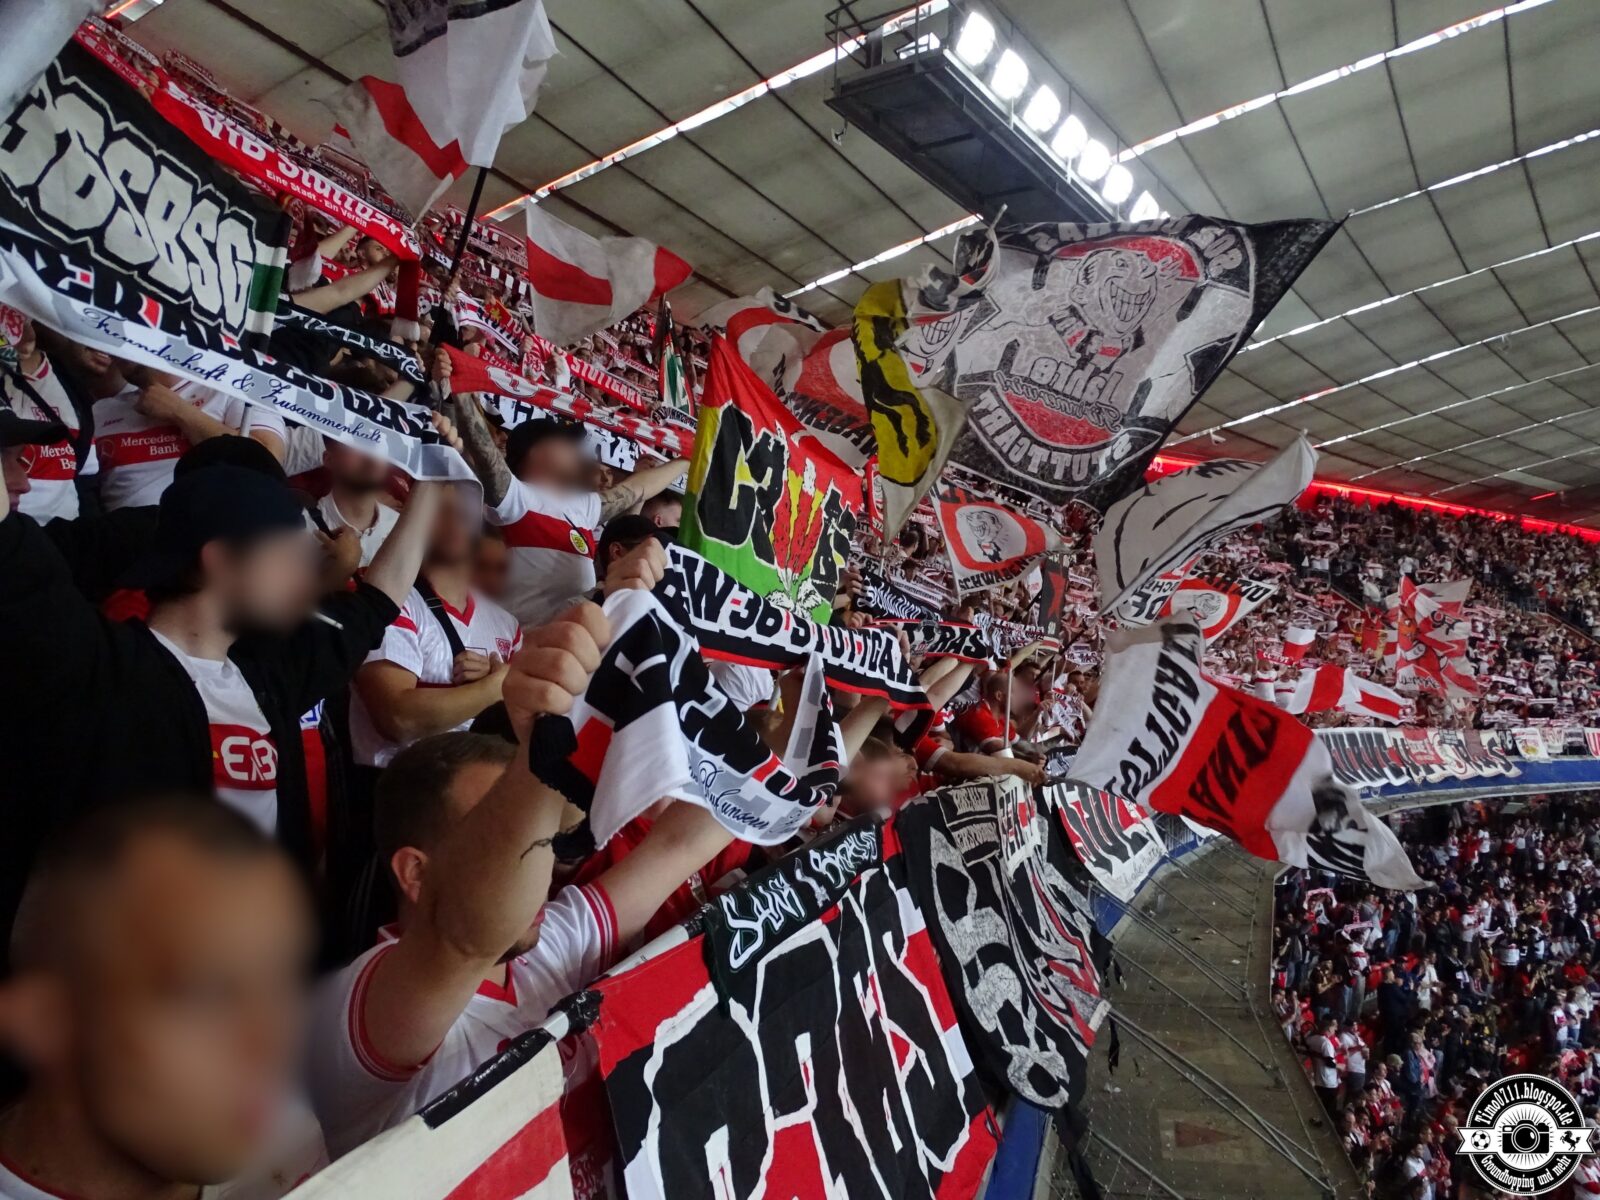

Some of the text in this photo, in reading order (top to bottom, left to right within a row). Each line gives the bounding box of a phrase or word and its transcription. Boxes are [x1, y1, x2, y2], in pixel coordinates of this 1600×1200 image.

[265, 169, 288, 187] Eine
[290, 182, 317, 202] Stadt
[324, 199, 340, 214] Ein
[340, 206, 368, 229] Verein
[278, 154, 414, 247] Stuttgart
[82, 306, 229, 384] Freundschaft
[232, 373, 255, 393] &
[261, 377, 384, 444] Zusammenhalt
[569, 355, 643, 407] STUTTGART
[40, 442, 76, 458] Mercede
[150, 443, 181, 457] Bank
